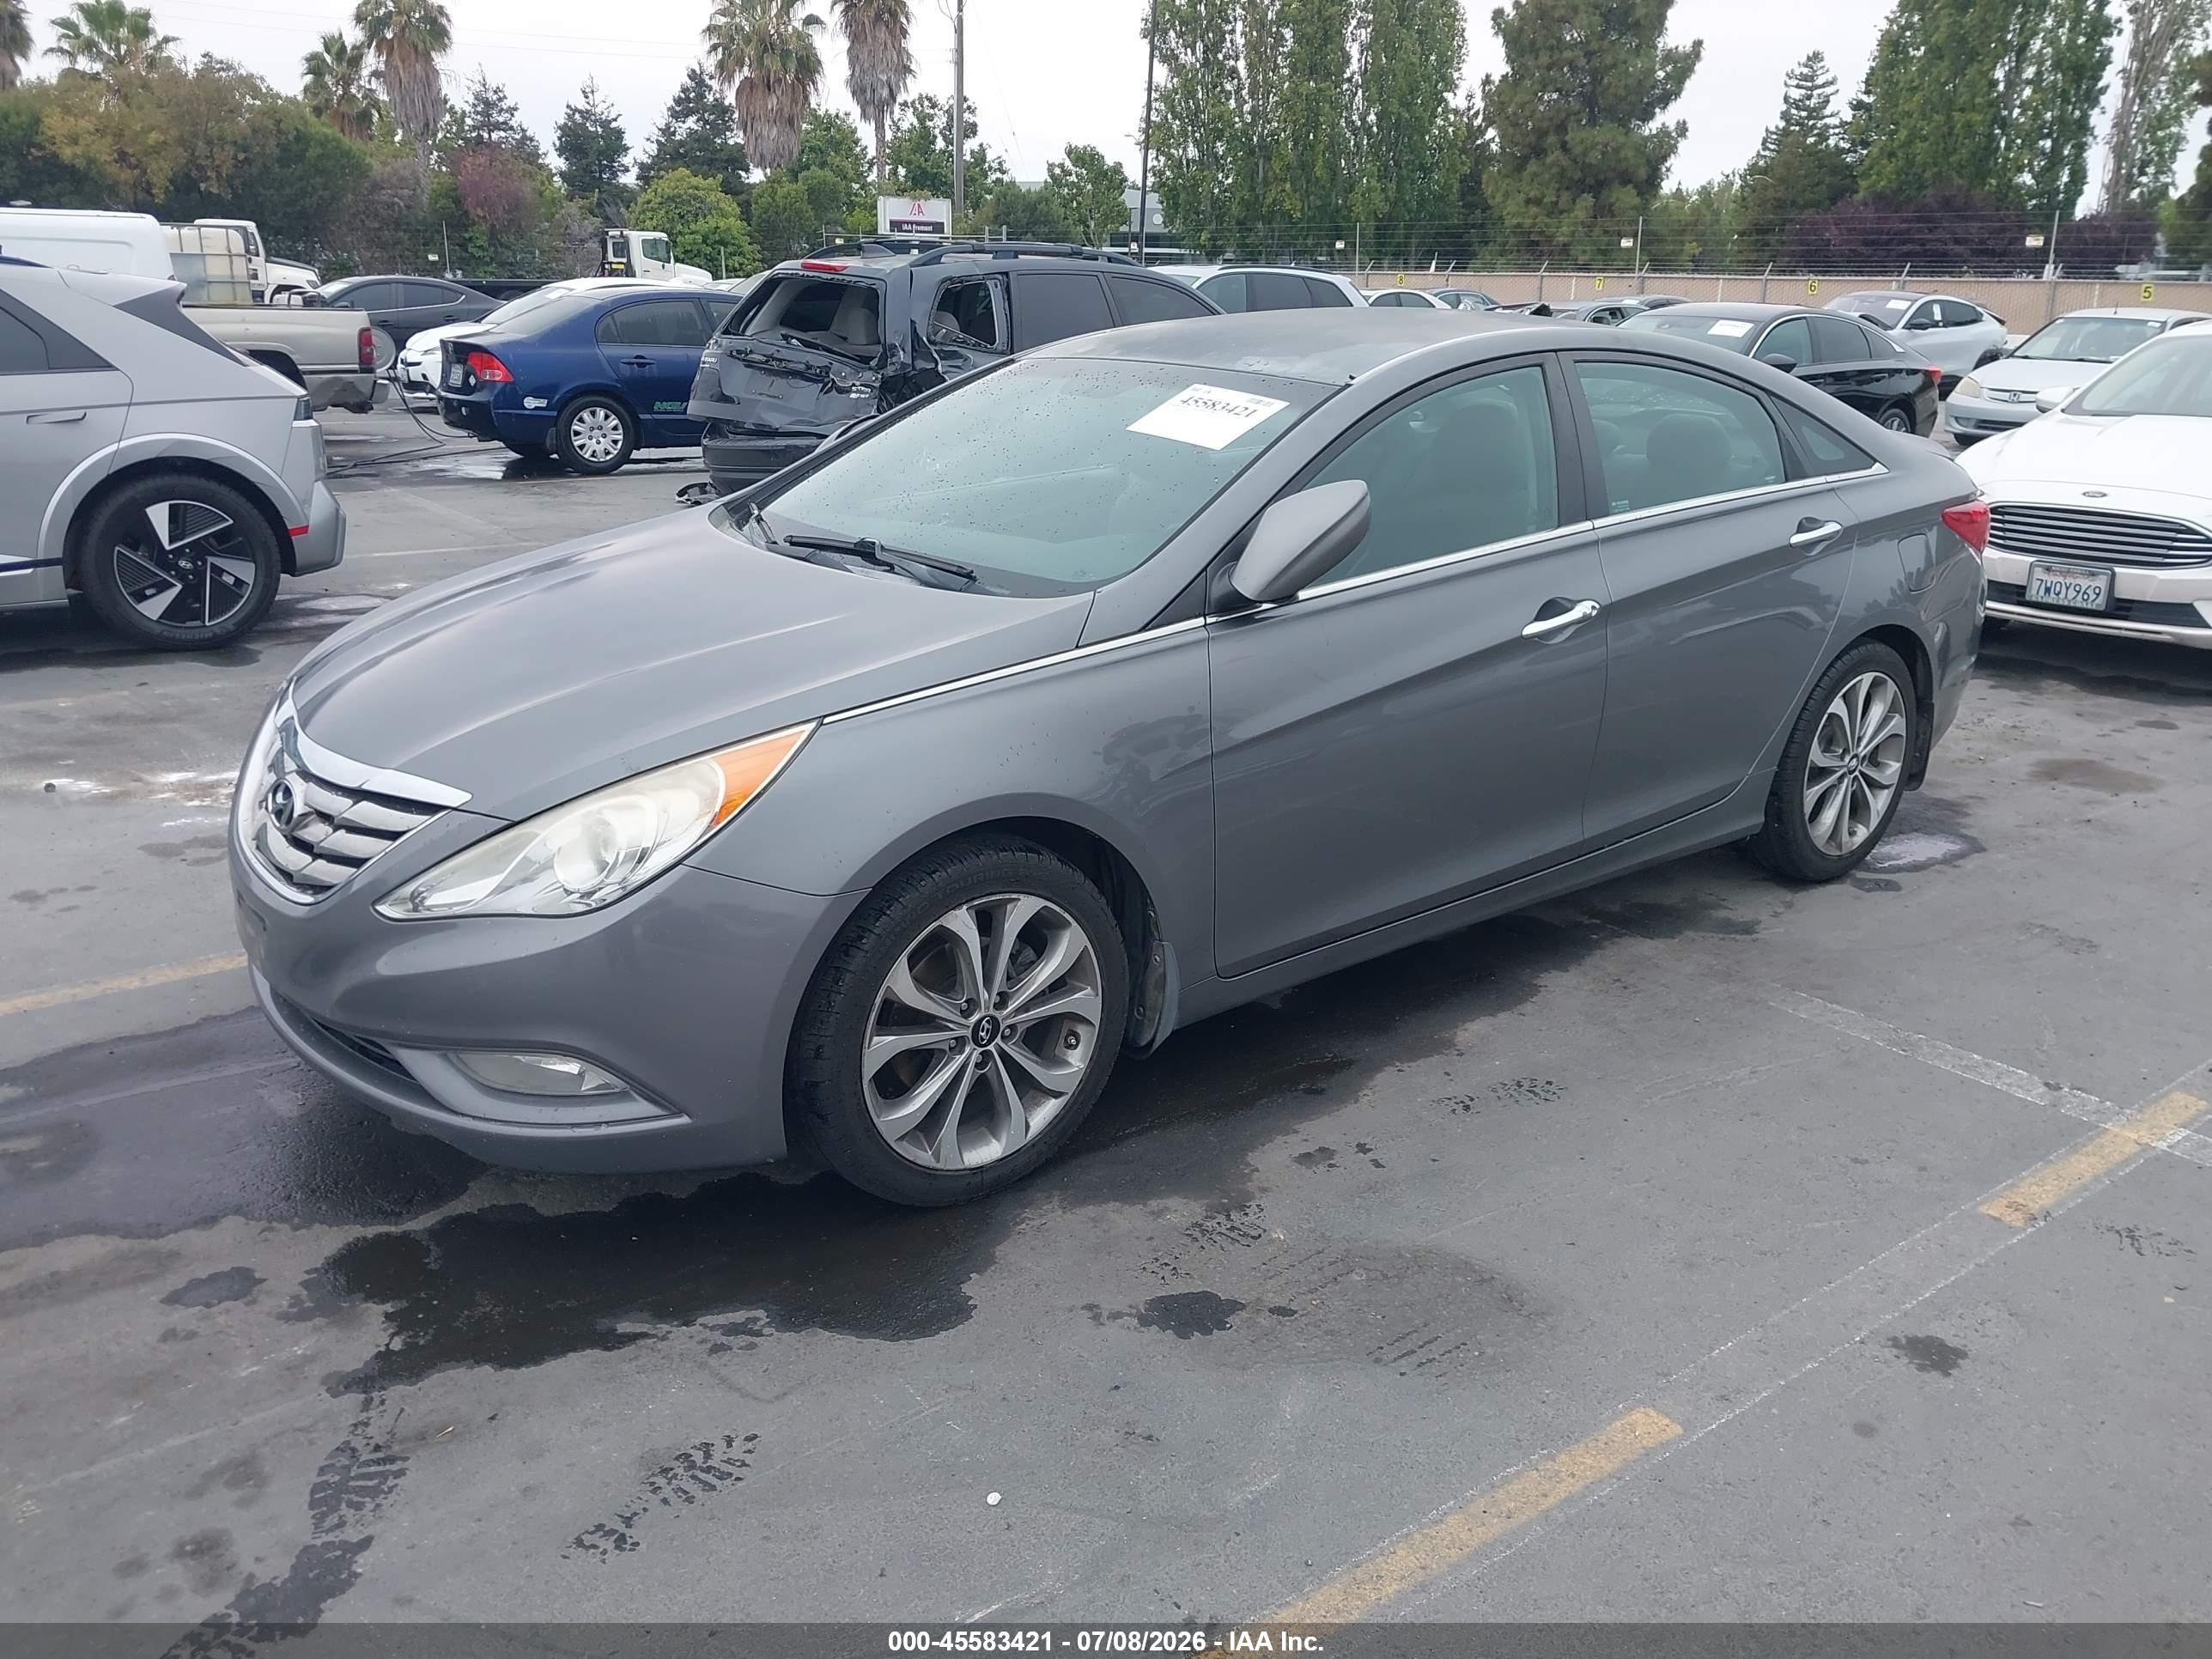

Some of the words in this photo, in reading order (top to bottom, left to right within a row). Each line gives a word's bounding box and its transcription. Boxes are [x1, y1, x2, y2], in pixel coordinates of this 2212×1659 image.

[1399, 275, 1403, 284] 8
[1596, 277, 1602, 289] 7
[1809, 281, 1817, 293] 6
[2142, 286, 2152, 299] 5
[1180, 395, 1259, 418] 45583421
[2035, 577, 2102, 604] 7WQY969
